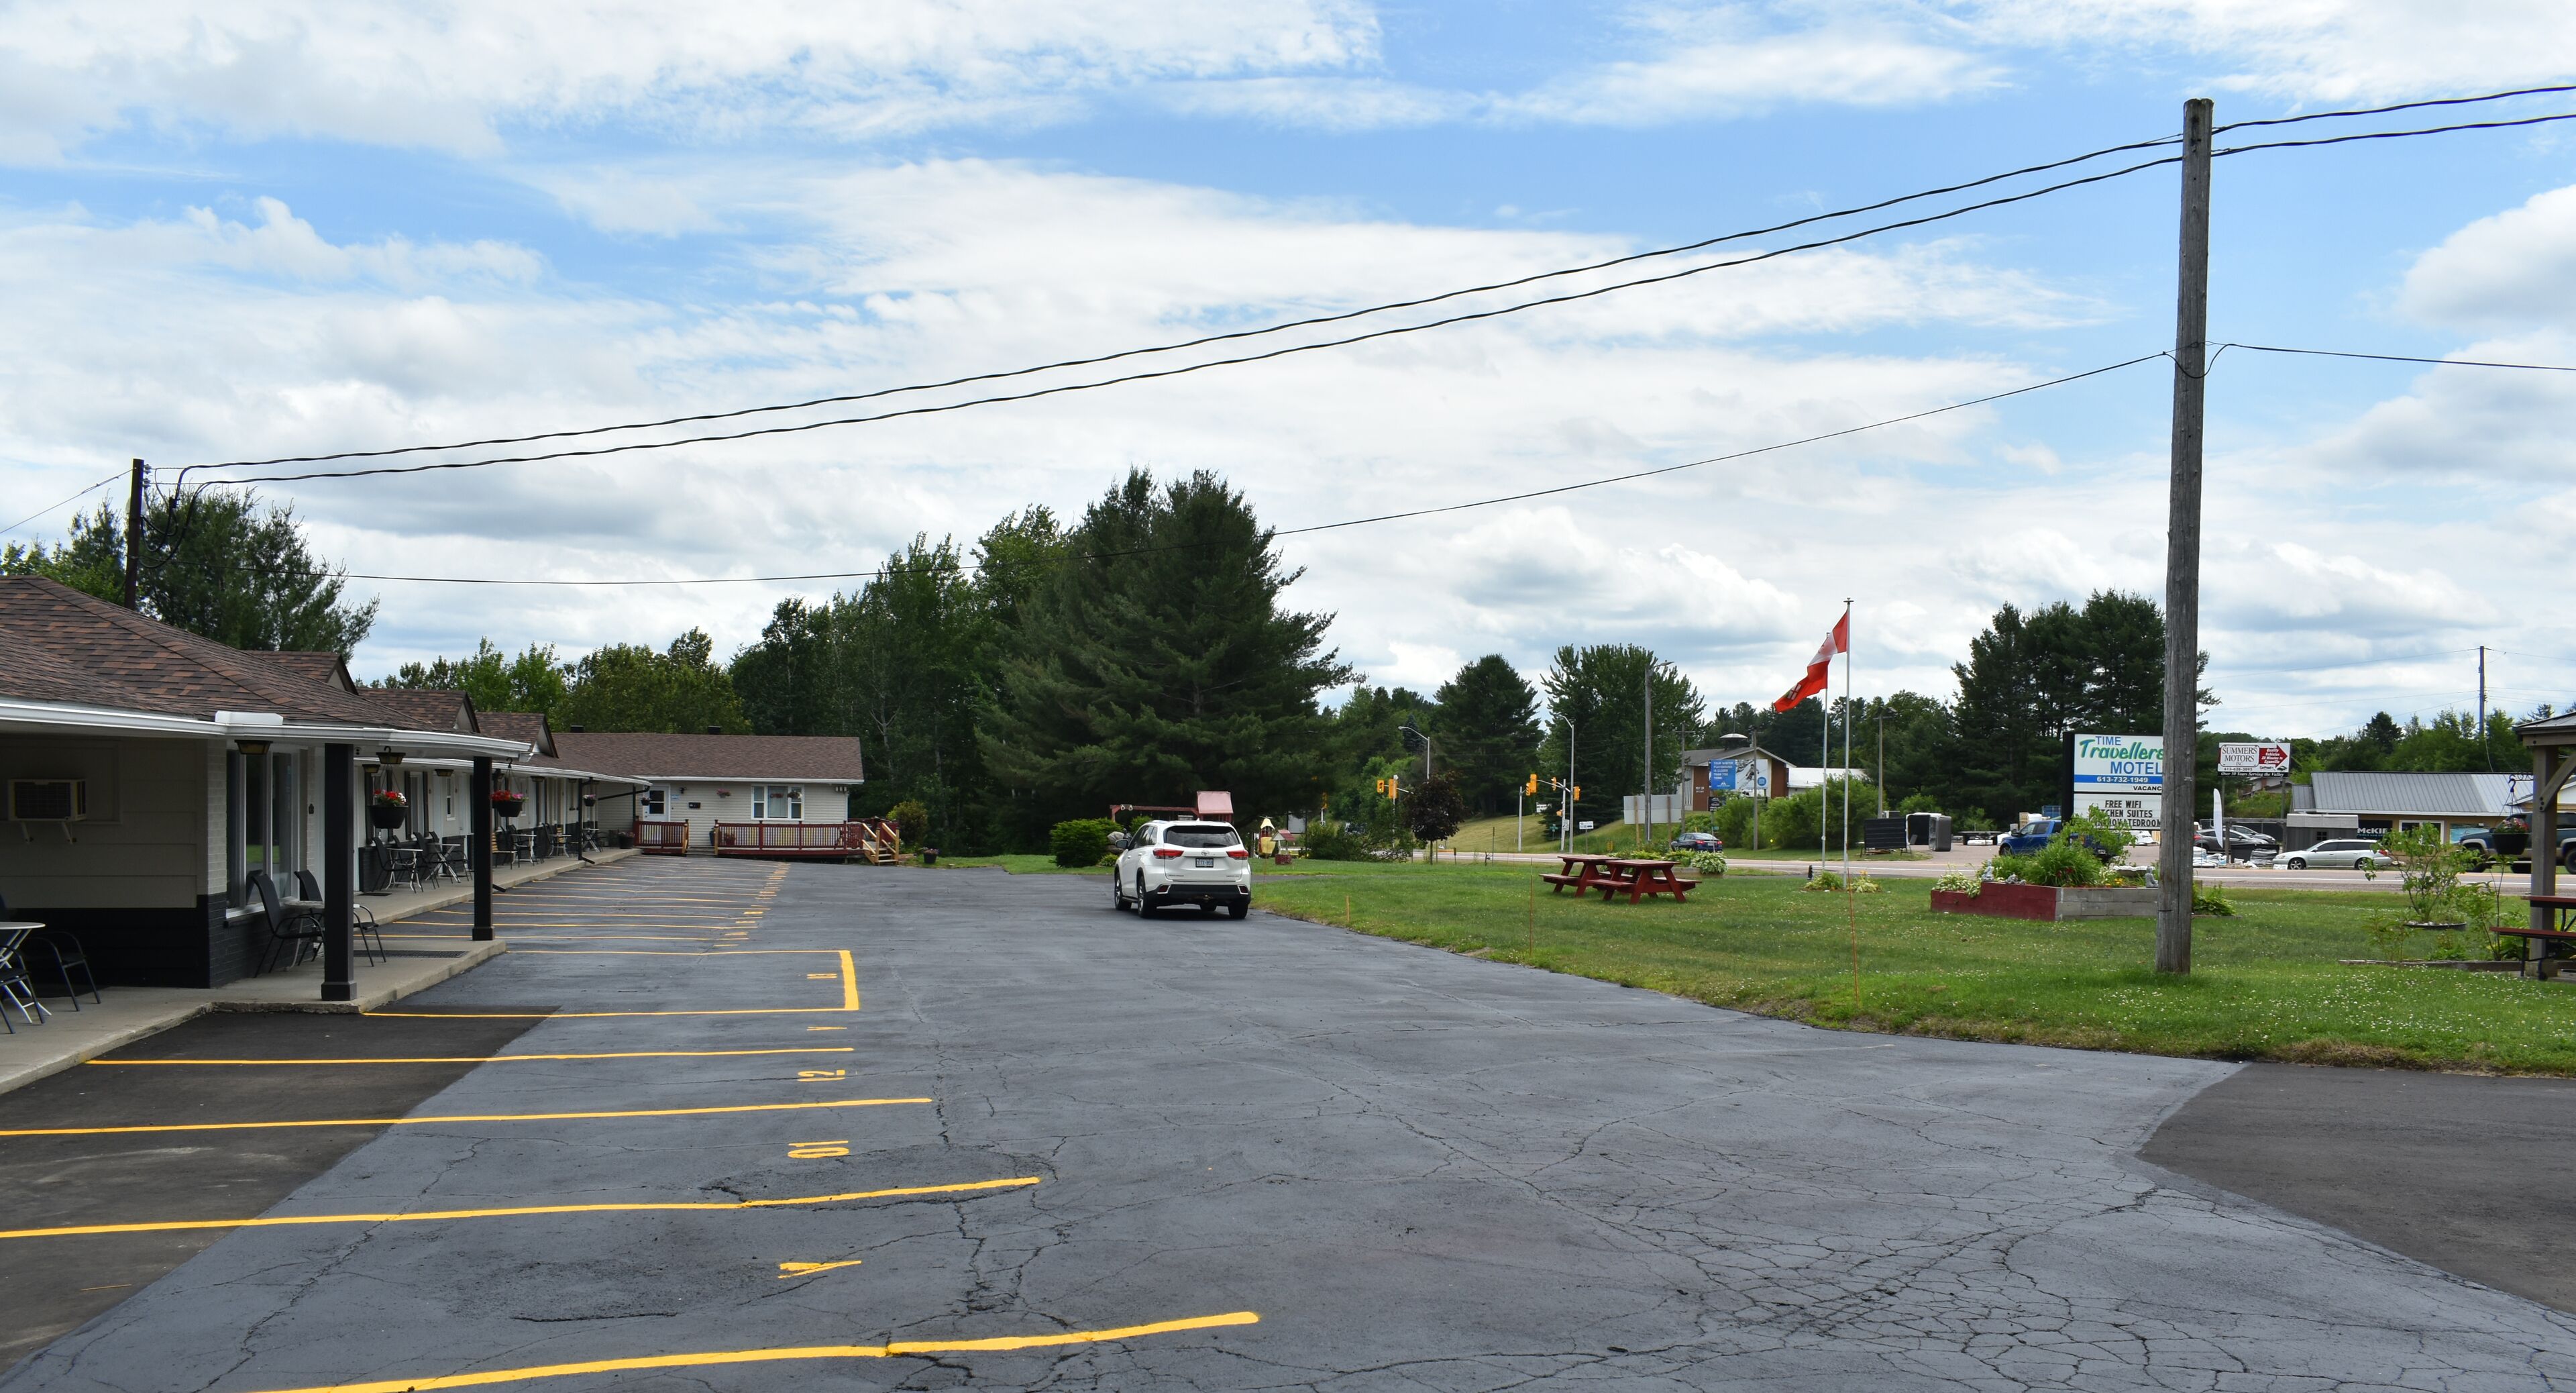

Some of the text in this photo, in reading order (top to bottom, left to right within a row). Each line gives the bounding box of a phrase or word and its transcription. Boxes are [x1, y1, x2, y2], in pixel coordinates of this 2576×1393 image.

[2095, 735, 2122, 746] TIME
[2079, 739, 2163, 760] Travellers
[2110, 761, 2163, 775] MOTEL
[2105, 800, 2142, 809] FREE WIFI
[2100, 809, 2153, 818] TCHEN SUITES
